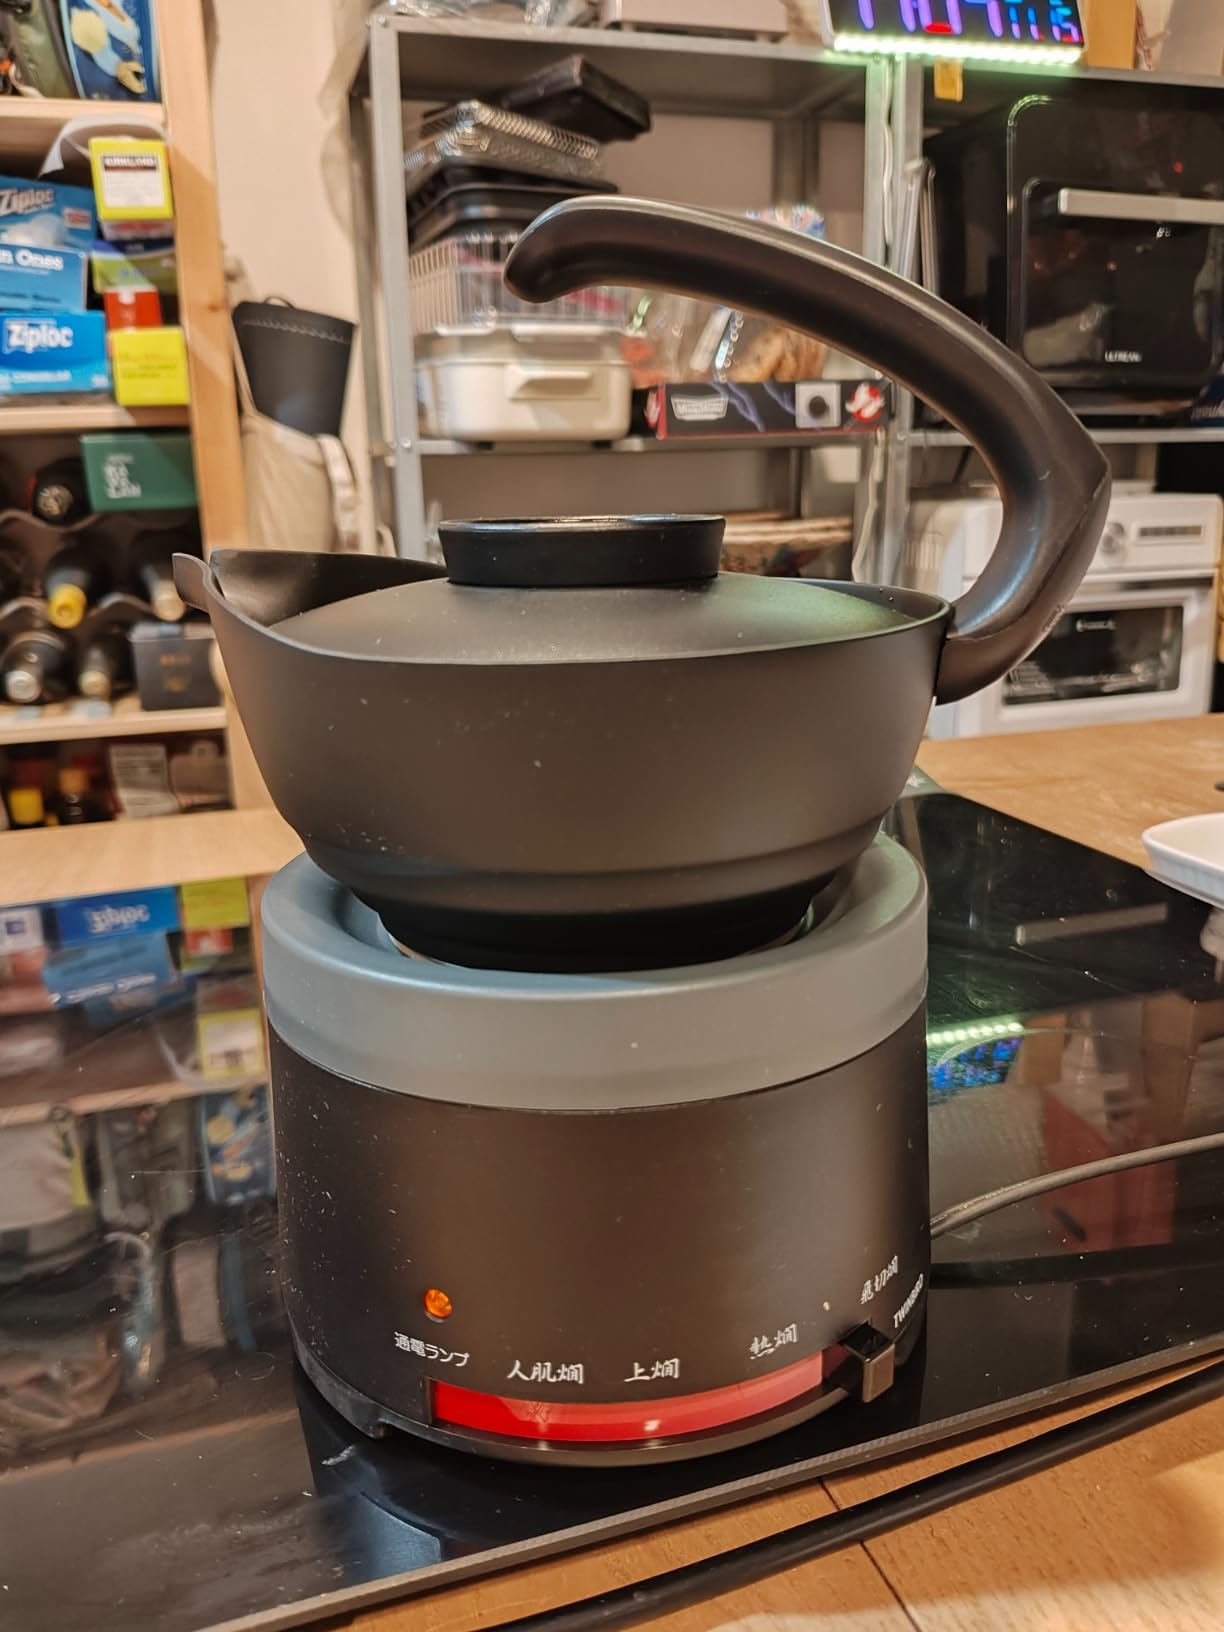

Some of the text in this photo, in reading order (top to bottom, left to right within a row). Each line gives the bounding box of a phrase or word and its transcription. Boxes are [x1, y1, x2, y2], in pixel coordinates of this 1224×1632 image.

[7, 321, 74, 354] Ziploc
[394, 1331, 470, 1367] 通電ランプ
[749, 1323, 798, 1360] 熱燗
[506, 1359, 585, 1385] 人肌燗
[623, 1357, 680, 1382] 上燗
